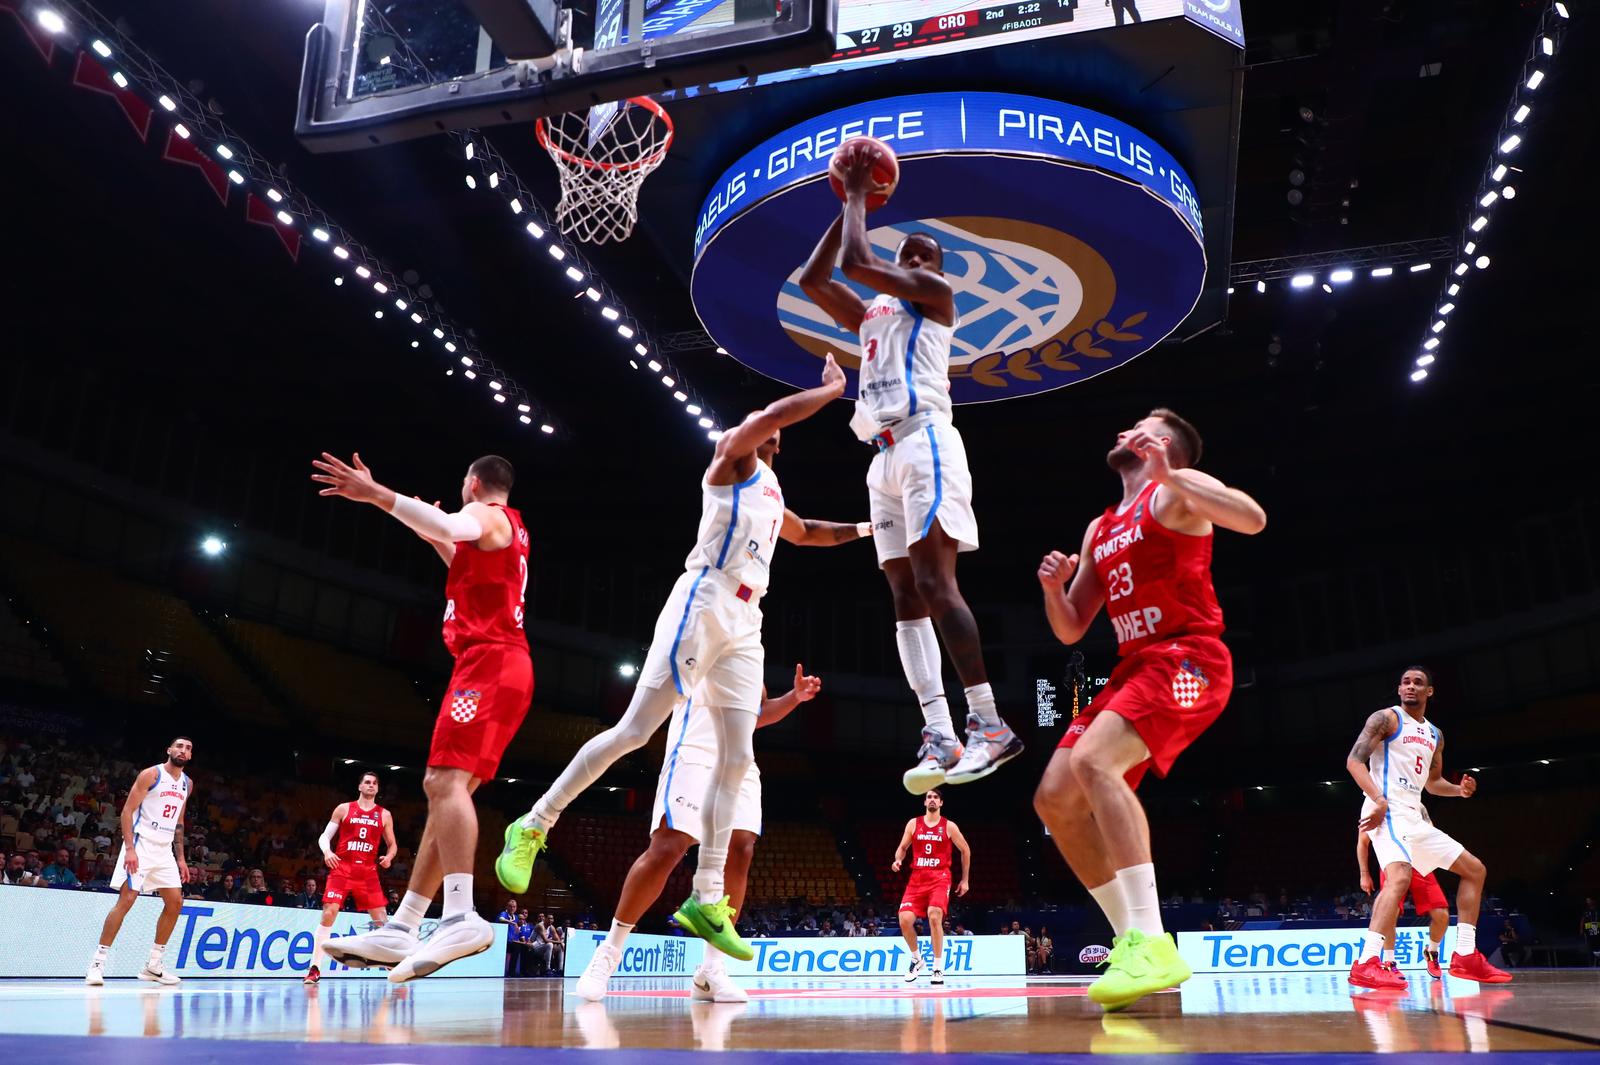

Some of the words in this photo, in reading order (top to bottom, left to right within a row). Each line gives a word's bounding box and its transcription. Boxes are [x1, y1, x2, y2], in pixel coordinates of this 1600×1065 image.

[861, 28, 880, 44] 27
[893, 23, 913, 39] 29
[938, 14, 966, 30] CRO
[986, 9, 1004, 20] 2nd
[1018, 3, 1040, 15] 2:22
[1187, 2, 1208, 19] TEAM
[1209, 14, 1232, 32] FOULS
[767, 111, 925, 180] GREECE
[998, 108, 1155, 176] PIRAEUS
[1107, 562, 1134, 602] 23
[1415, 755, 1424, 775] 5
[163, 804, 178, 820] 27
[358, 827, 368, 839] 8
[925, 843, 933, 855] 9
[662, 939, 686, 972] 腾讯
[750, 940, 906, 972] Tencent
